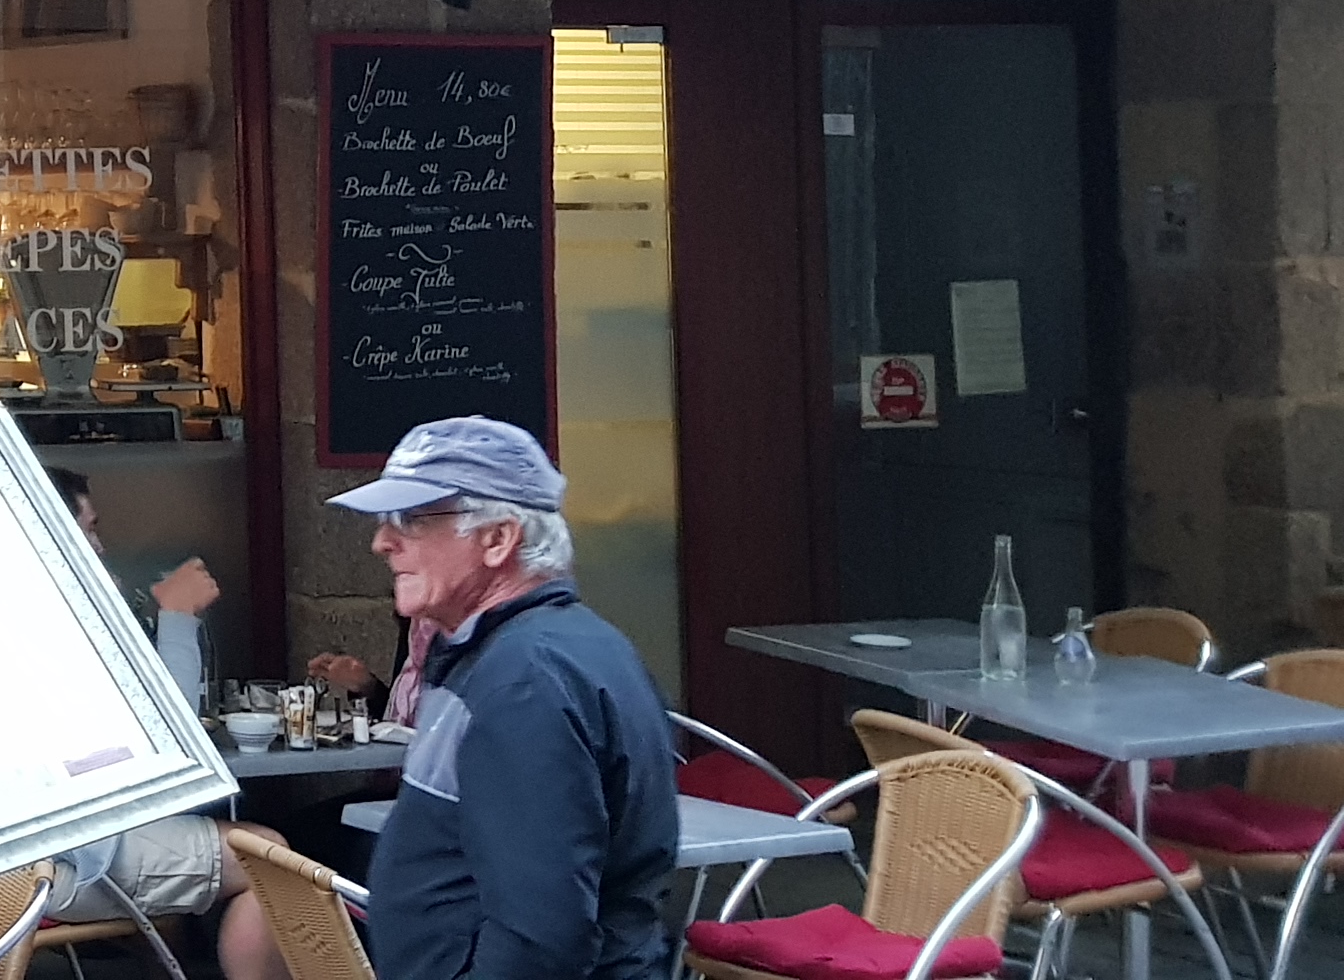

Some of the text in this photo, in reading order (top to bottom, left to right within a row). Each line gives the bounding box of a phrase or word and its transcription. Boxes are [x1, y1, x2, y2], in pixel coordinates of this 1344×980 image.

[347, 57, 512, 124] Menu 14,80€
[342, 126, 416, 151] Brochette
[425, 130, 446, 151] de
[419, 162, 439, 174] ou
[422, 176, 442, 194] de
[448, 169, 509, 192] Poulet
[342, 219, 382, 238] Frites
[390, 223, 433, 237] maison
[449, 213, 493, 233] Salade
[350, 264, 456, 304] Coupe Julie
[421, 323, 442, 335] ou
[352, 336, 470, 371] Crêpe Karine
